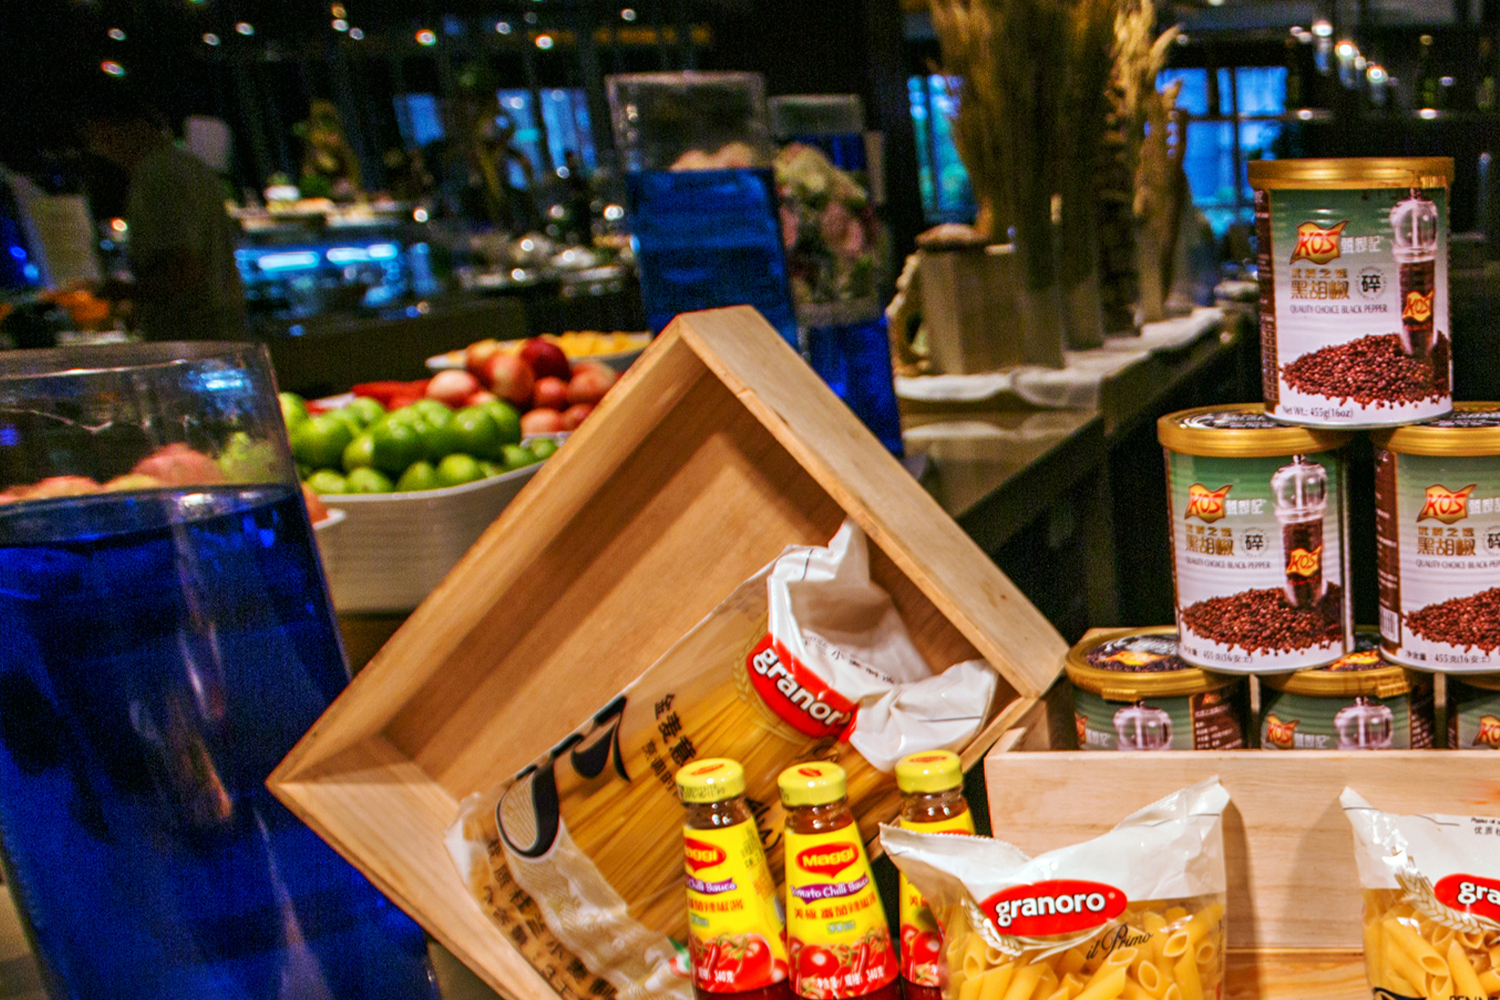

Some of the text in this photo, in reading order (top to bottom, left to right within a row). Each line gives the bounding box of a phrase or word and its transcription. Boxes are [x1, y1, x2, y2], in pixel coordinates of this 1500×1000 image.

[1295, 230, 1340, 256] KOS
[1291, 280, 1350, 300] 黑胡椒
[1361, 274, 1381, 292] 碎
[1290, 303, 1388, 314] QUALITY CHOICE BLACK PEPPER
[1188, 492, 1224, 515] KOS
[1423, 493, 1467, 516] KOS
[1185, 534, 1234, 556] 黑胡椒
[1245, 533, 1264, 551] 碎
[1417, 537, 1476, 556] 黑胡椒
[1227, 560, 1246, 569] BLACK
[1247, 561, 1271, 569] PEPPER
[1290, 552, 1318, 571] KOS
[1416, 559, 1440, 568] QUALITY
[1442, 561, 1466, 569] CHOICE
[1468, 561, 1488, 569] BLACK
[802, 847, 855, 867] Maggi
[823, 882, 847, 898] Chilli
[995, 892, 1106, 927] granoro
[1100, 922, 1154, 960] Primo
